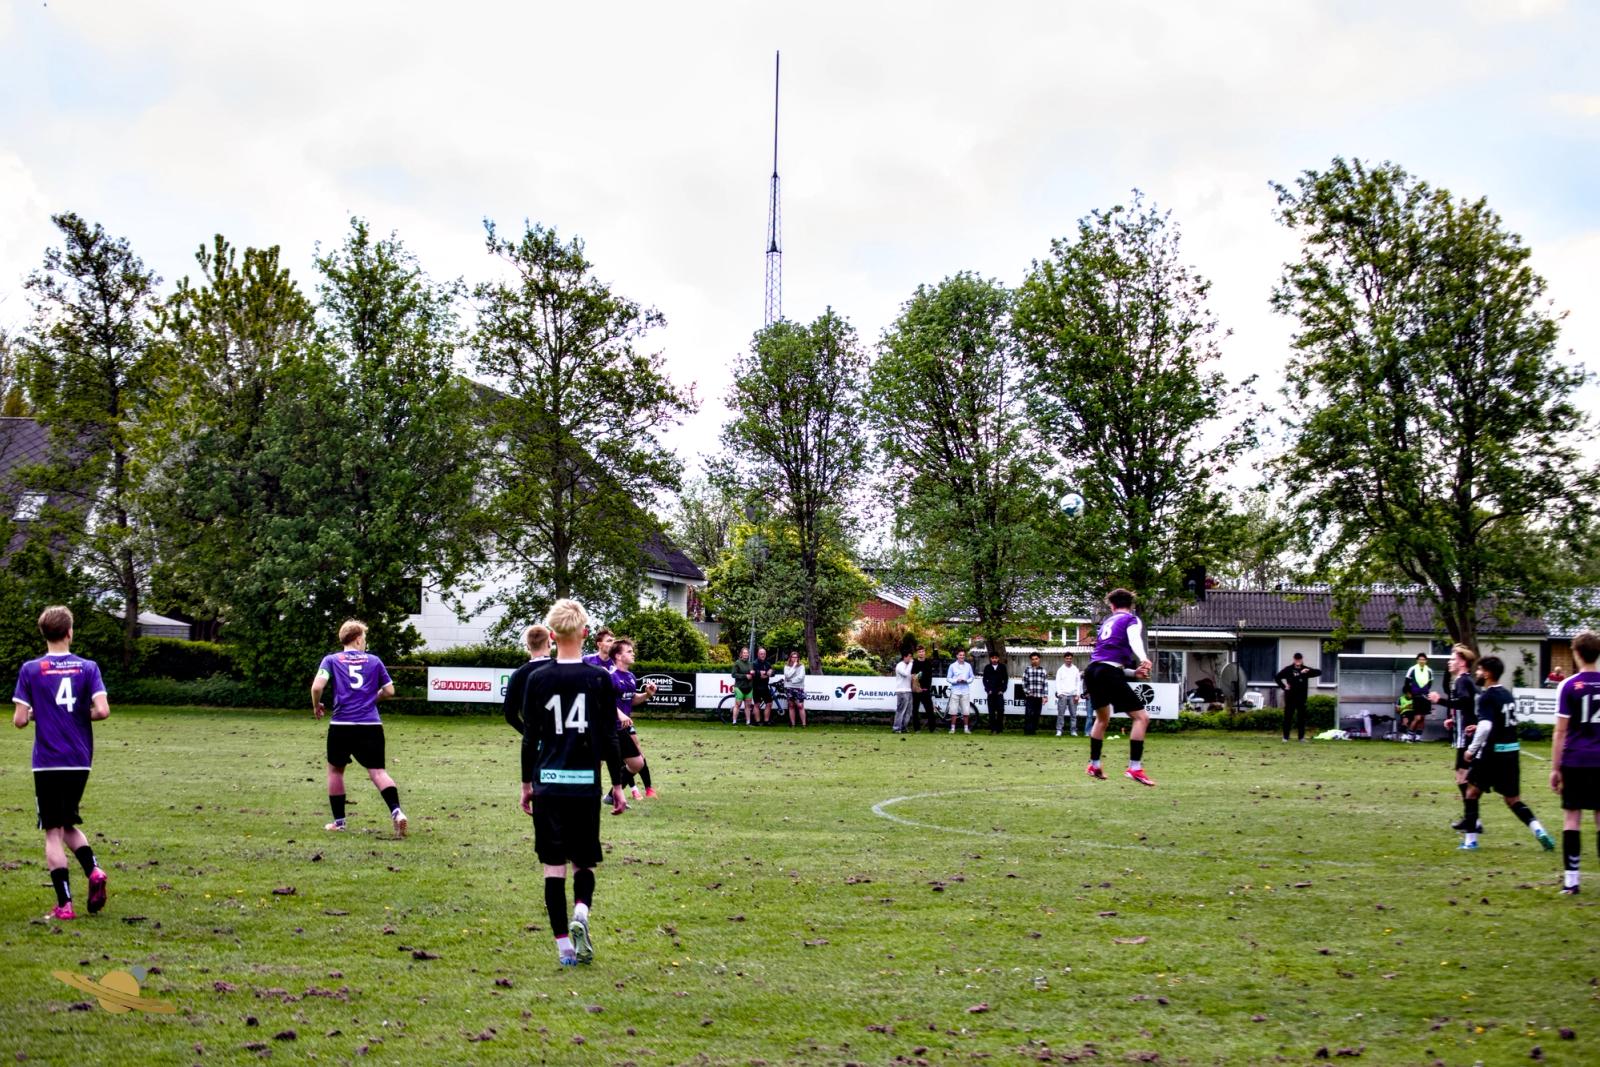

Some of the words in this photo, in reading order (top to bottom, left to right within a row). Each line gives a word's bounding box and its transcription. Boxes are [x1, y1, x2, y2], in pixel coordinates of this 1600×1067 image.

[348, 664, 364, 689] 5
[440, 681, 491, 691] BAUHAUS
[55, 677, 77, 713] 4
[1580, 694, 1600, 723] 12
[544, 693, 588, 735] 14
